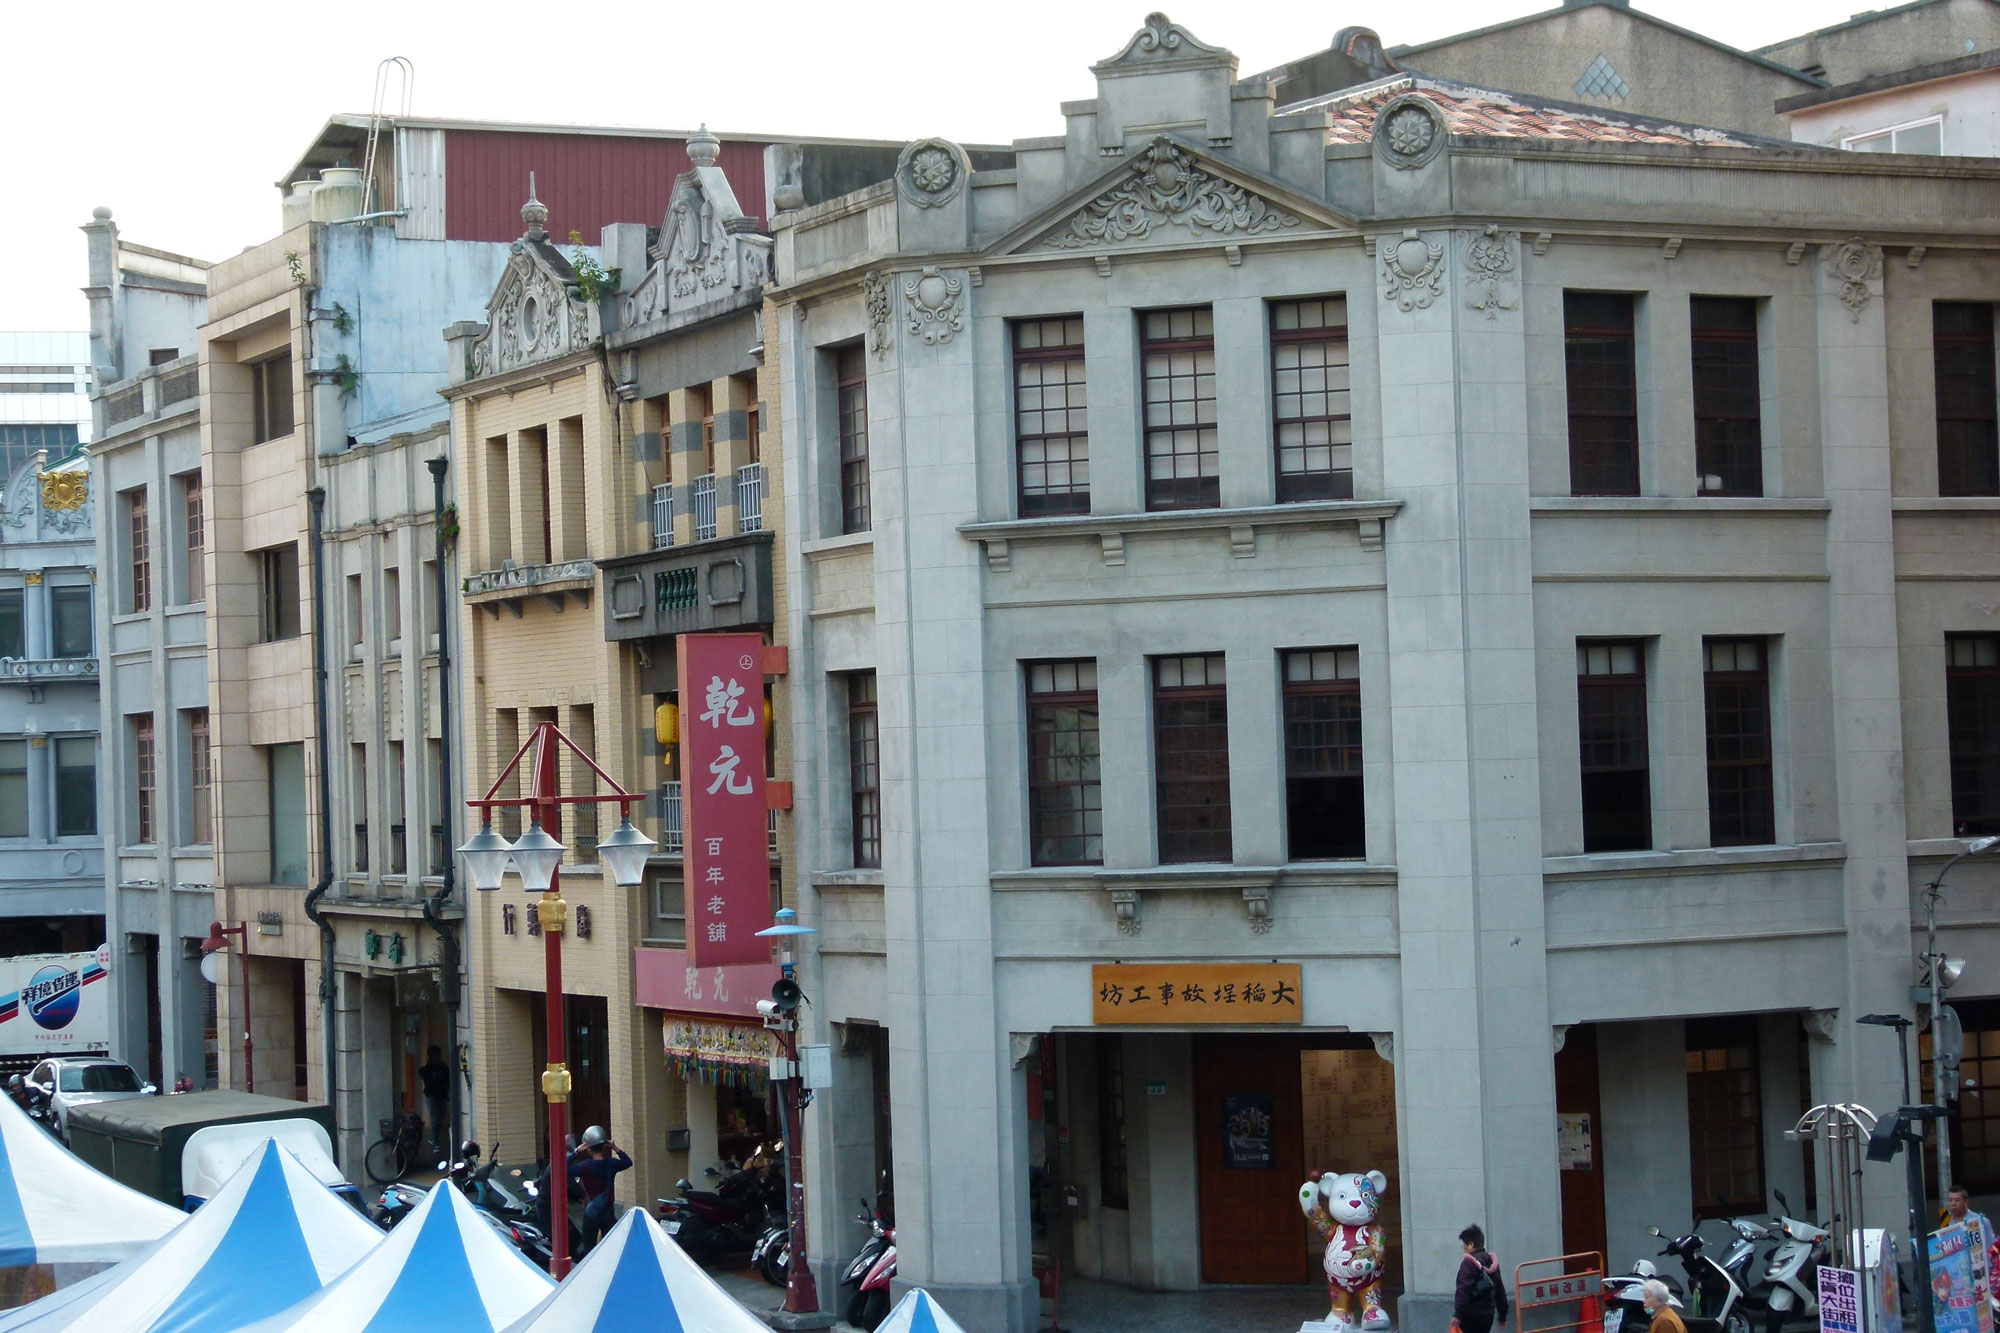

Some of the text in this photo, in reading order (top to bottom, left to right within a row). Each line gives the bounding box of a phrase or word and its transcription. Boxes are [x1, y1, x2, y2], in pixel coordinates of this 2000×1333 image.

[699, 675, 754, 795] 乾元
[704, 836, 726, 942] 百年老舖
[22, 971, 78, 1004] 祥億貨運
[684, 966, 729, 1002] 乾元
[1536, 1279, 1586, 1298] 車輛改道
[1820, 1268, 1838, 1321] 年貨大街
[1837, 1271, 1857, 1325] 攤位出租
